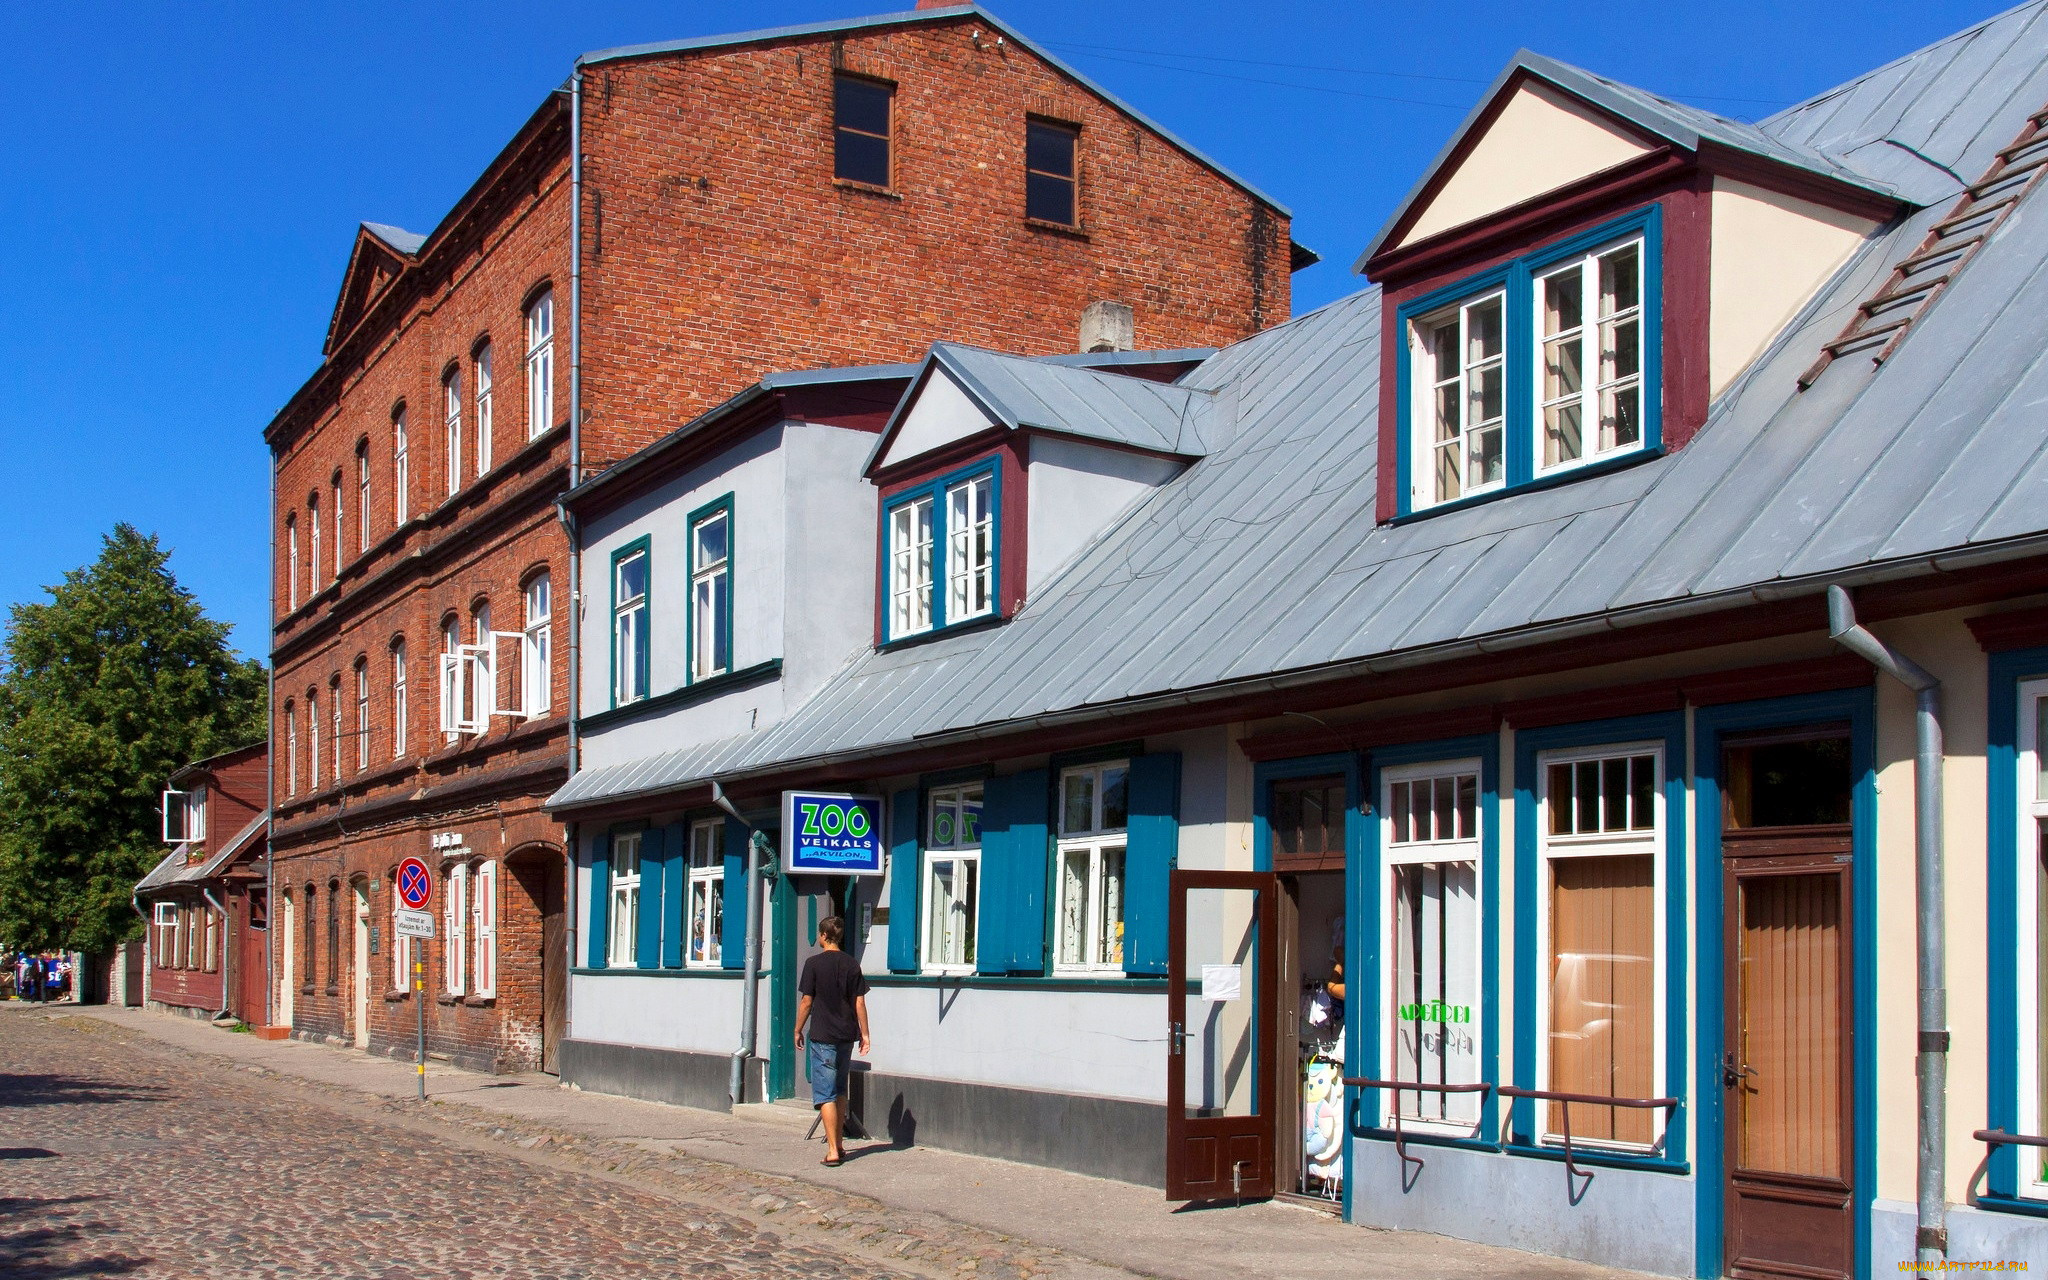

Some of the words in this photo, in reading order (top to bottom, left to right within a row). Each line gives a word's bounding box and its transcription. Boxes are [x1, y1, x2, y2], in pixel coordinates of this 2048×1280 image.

[801, 803, 871, 838] ZOO
[801, 838, 872, 848] VEIKALS
[1397, 1000, 1470, 1023] APGĒRBI
